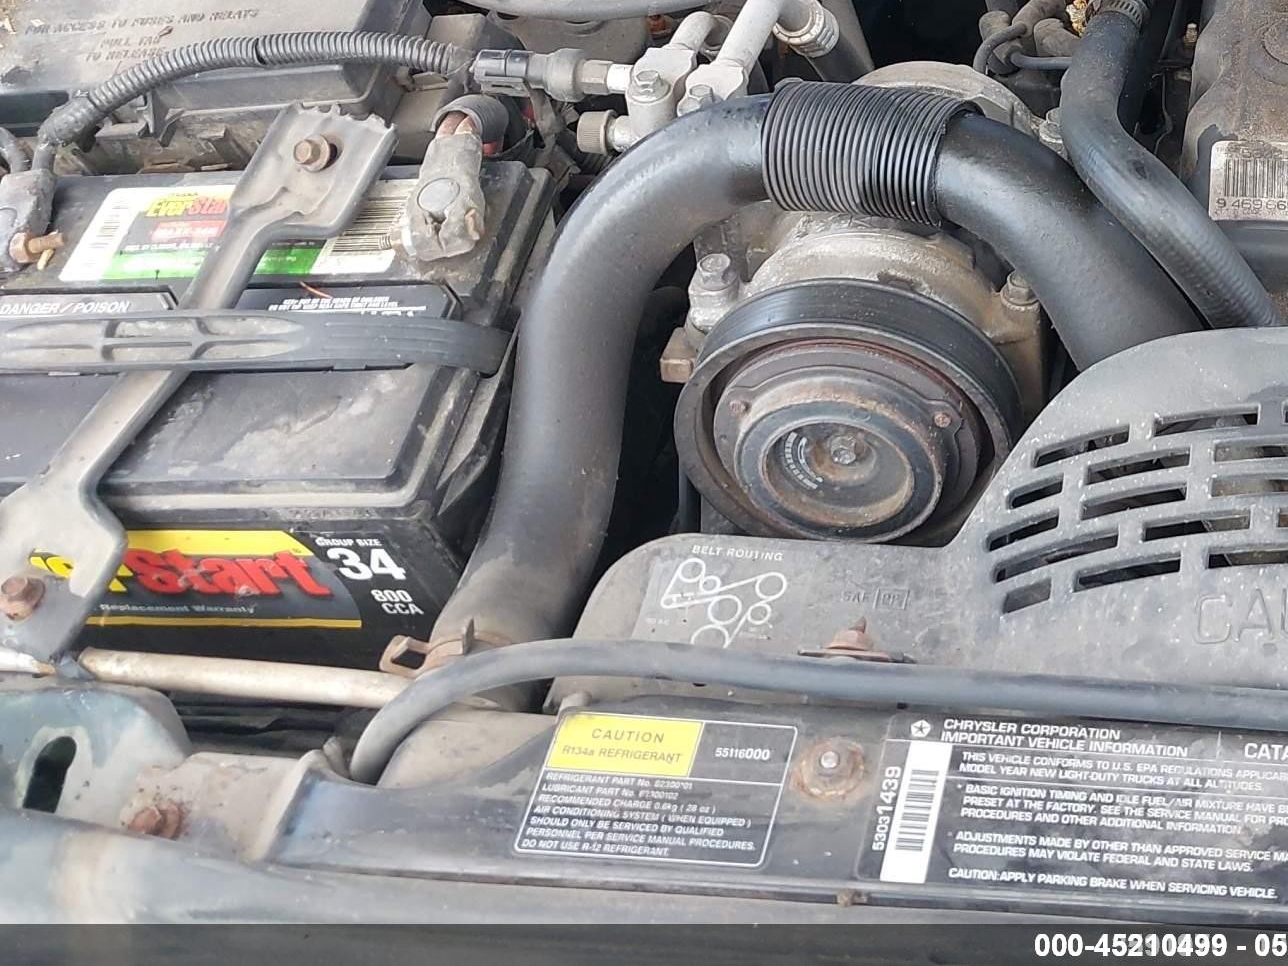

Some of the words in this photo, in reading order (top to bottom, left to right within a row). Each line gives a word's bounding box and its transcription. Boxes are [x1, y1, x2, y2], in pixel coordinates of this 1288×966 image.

[1215, 198, 1227, 209] 9
[314, 536, 355, 547] GROUP
[356, 537, 383, 547] SIZE
[326, 547, 407, 581] 34
[691, 544, 724, 556] BELT
[725, 548, 784, 563] ROUTING
[370, 589, 414, 603] 800
[193, 603, 256, 616] Warranty
[381, 602, 425, 615] CCA
[591, 728, 665, 743] CAUTION
[943, 718, 1018, 734] CHRYSLER
[1020, 723, 1121, 740] CORPORATION
[599, 747, 683, 762] REFRIGERANT
[714, 747, 771, 760] 55116000
[940, 731, 1025, 747] IMPORTANT
[1027, 736, 1085, 752] VEHICLE
[1089, 738, 1188, 757] INFORMATION
[871, 765, 902, 851] 53031439
[965, 784, 998, 796] BASIC
[999, 787, 1048, 798] IGNITION
[1049, 789, 1088, 801] TIMING
[1088, 792, 1114, 803] AND
[1115, 794, 1141, 804] IDLE
[1141, 795, 1194, 808] FUEL/AIR
[1194, 797, 1244, 811] MIXTURE
[1245, 802, 1276, 813] HAVE
[962, 795, 1005, 808] PRESET
[1005, 798, 1023, 808] AT
[1023, 799, 1045, 810] THE
[1045, 801, 1098, 814] FACTORY.
[1100, 805, 1122, 816] SEE
[1123, 806, 1146, 817] THE
[1146, 808, 1193, 820] SERVICE
[1194, 810, 1242, 823] MANUAL
[1243, 813, 1267, 824] FOR
[529, 815, 569, 826] SHOULD
[570, 818, 597, 828] ONLY
[596, 820, 611, 830] BE
[612, 821, 659, 832] SERVICED
[659, 823, 673, 833] BY
[674, 824, 725, 836] QUALIFIED
[955, 830, 1037, 846] ADJUSTMENTS
[1037, 835, 1072, 848] MADE
[1073, 837, 1090, 849] BY
[1091, 839, 1129, 851] OTHER
[1130, 841, 1163, 853] THAN
[1163, 844, 1225, 859] APPROVED
[1225, 848, 1271, 861] SERVICE
[952, 842, 1027, 858] PROCEDURES
[1027, 846, 1055, 859] MAY
[1055, 849, 1101, 862] VIOLATE
[1102, 852, 1152, 865] FEDERAL
[1153, 855, 1180, 867] AND
[1180, 857, 1216, 870] STATE
[1217, 860, 1255, 872] LAWS.
[1036, 872, 1089, 887] PARKING
[1088, 875, 1128, 890] BRAKE
[1129, 878, 1168, 892] WHEN
[1167, 881, 1228, 896] SERVICING
[1228, 884, 1279, 899] VEHICLE.
